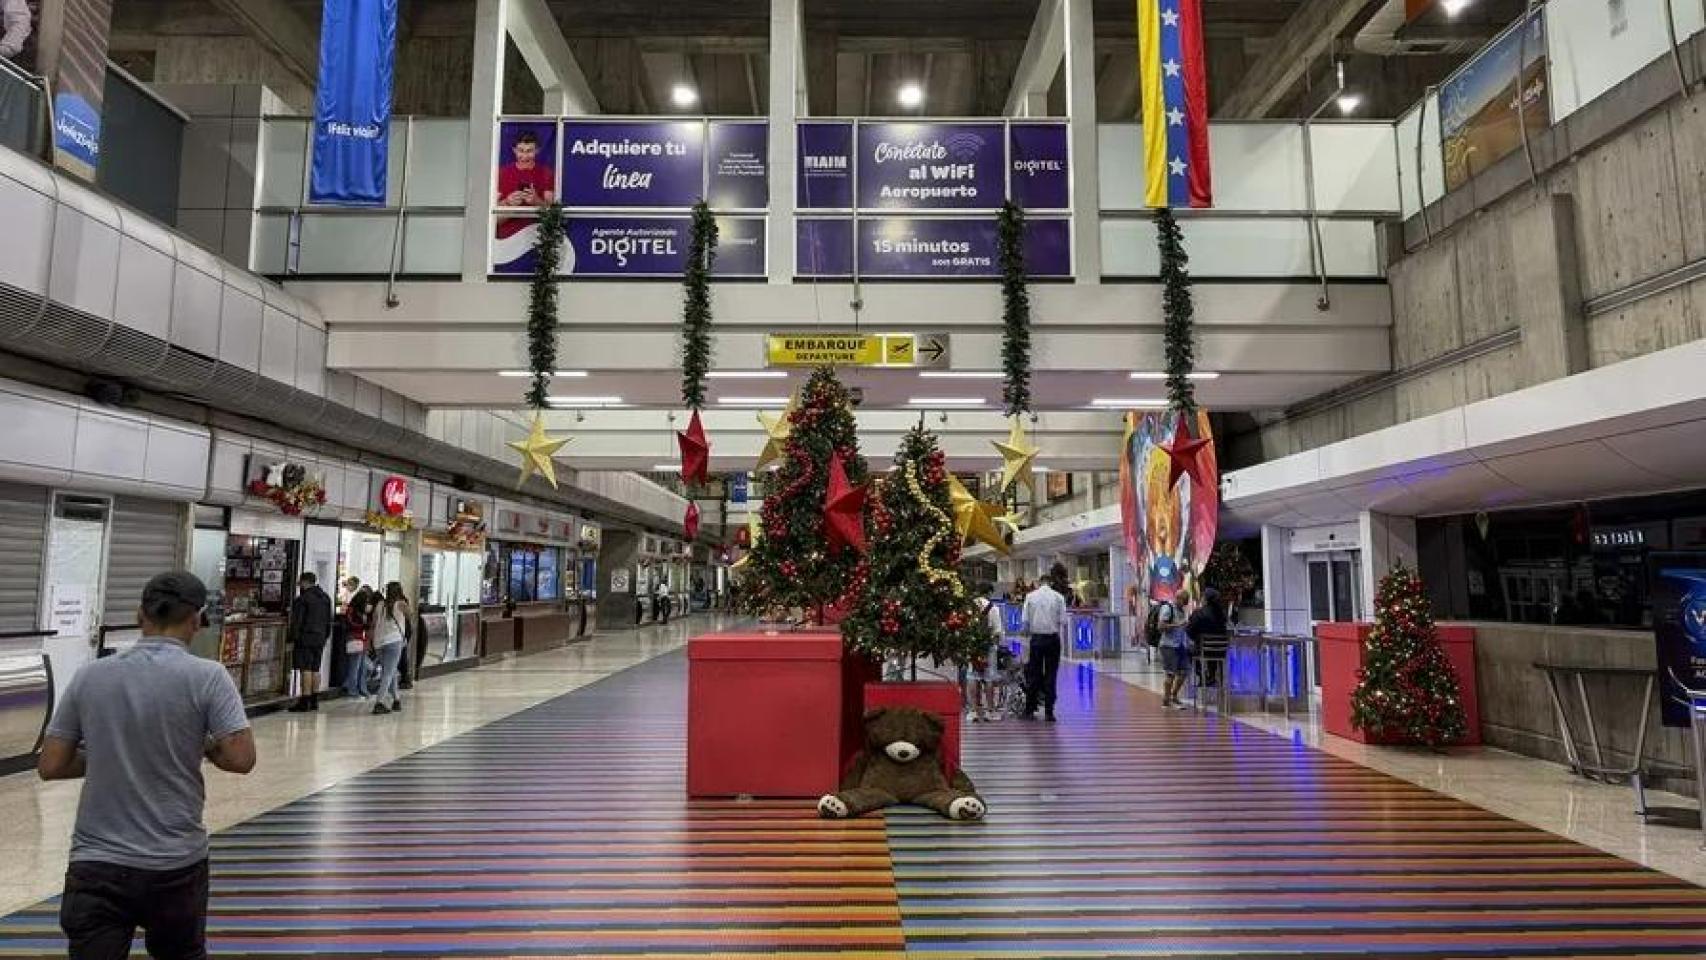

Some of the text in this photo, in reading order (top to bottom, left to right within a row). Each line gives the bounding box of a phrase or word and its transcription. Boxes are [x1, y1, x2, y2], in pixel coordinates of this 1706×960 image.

[571, 138, 687, 159] Adquiere tu
[602, 163, 653, 190] línea
[908, 163, 976, 180] al WiFi
[880, 184, 978, 200] Aeropuerto
[591, 228, 625, 238] Agente
[591, 236, 678, 267] DIGITEL
[872, 238, 971, 253] 15 minutos
[952, 257, 991, 267] GRATIS
[784, 339, 868, 351] EMBARQUE
[795, 352, 857, 361] DEPARTURE
